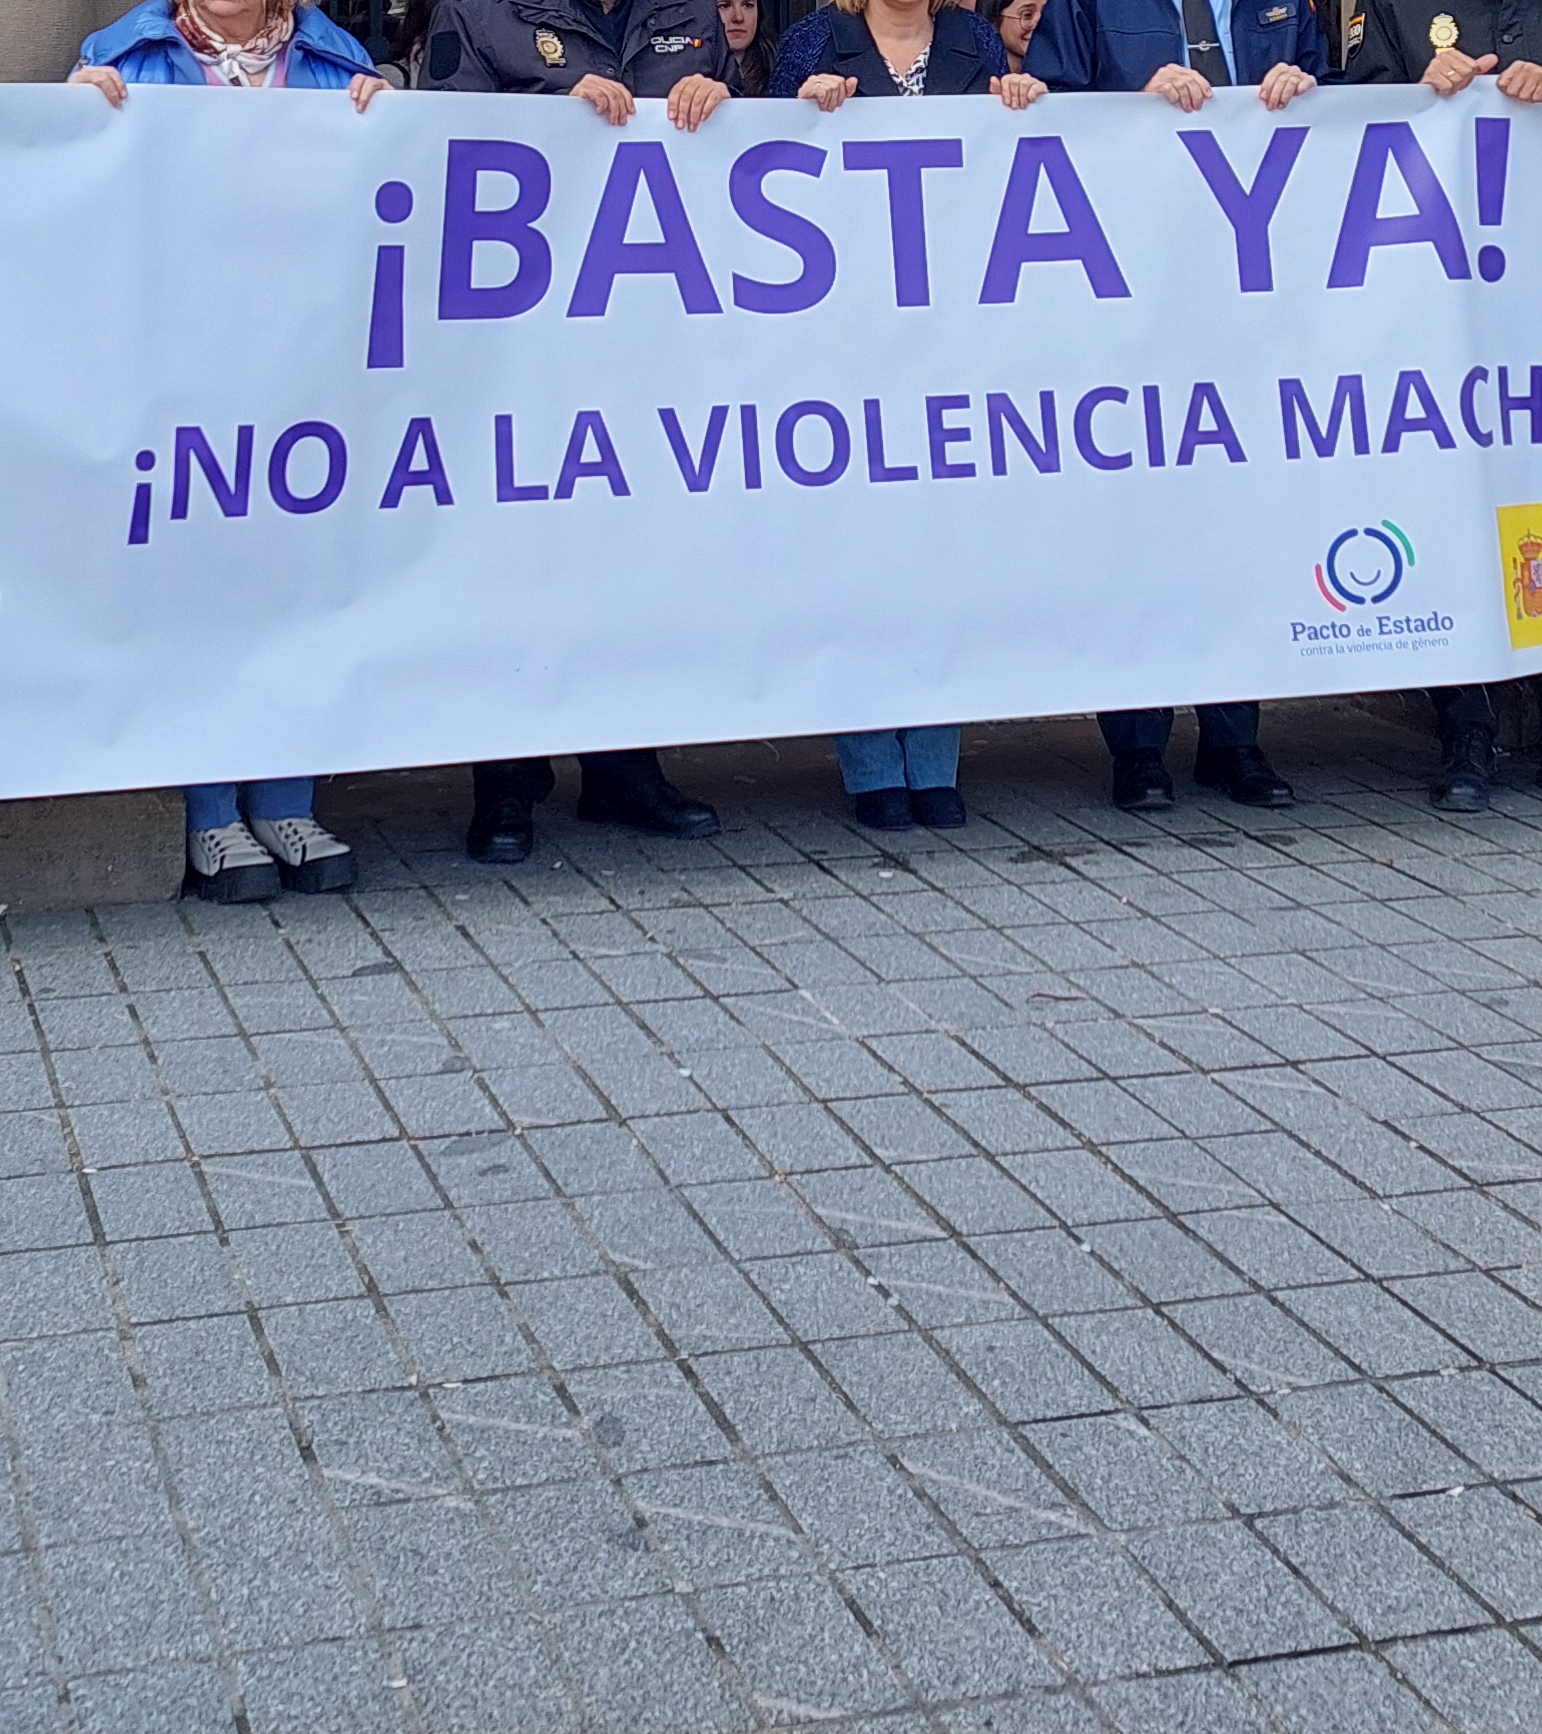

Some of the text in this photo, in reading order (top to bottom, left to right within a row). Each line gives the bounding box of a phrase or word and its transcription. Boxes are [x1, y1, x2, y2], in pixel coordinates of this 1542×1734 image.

[655, 45, 684, 53] CNP
[365, 116, 1511, 369] ¡BASTA YA!
[126, 420, 348, 546] ¡NO
[379, 416, 455, 509] A
[494, 410, 632, 503] LA
[657, 381, 1247, 493] VIOLENCIA
[1290, 611, 1454, 641] Pacto de Estado
[1300, 636, 1449, 656] contra la violencia de género
